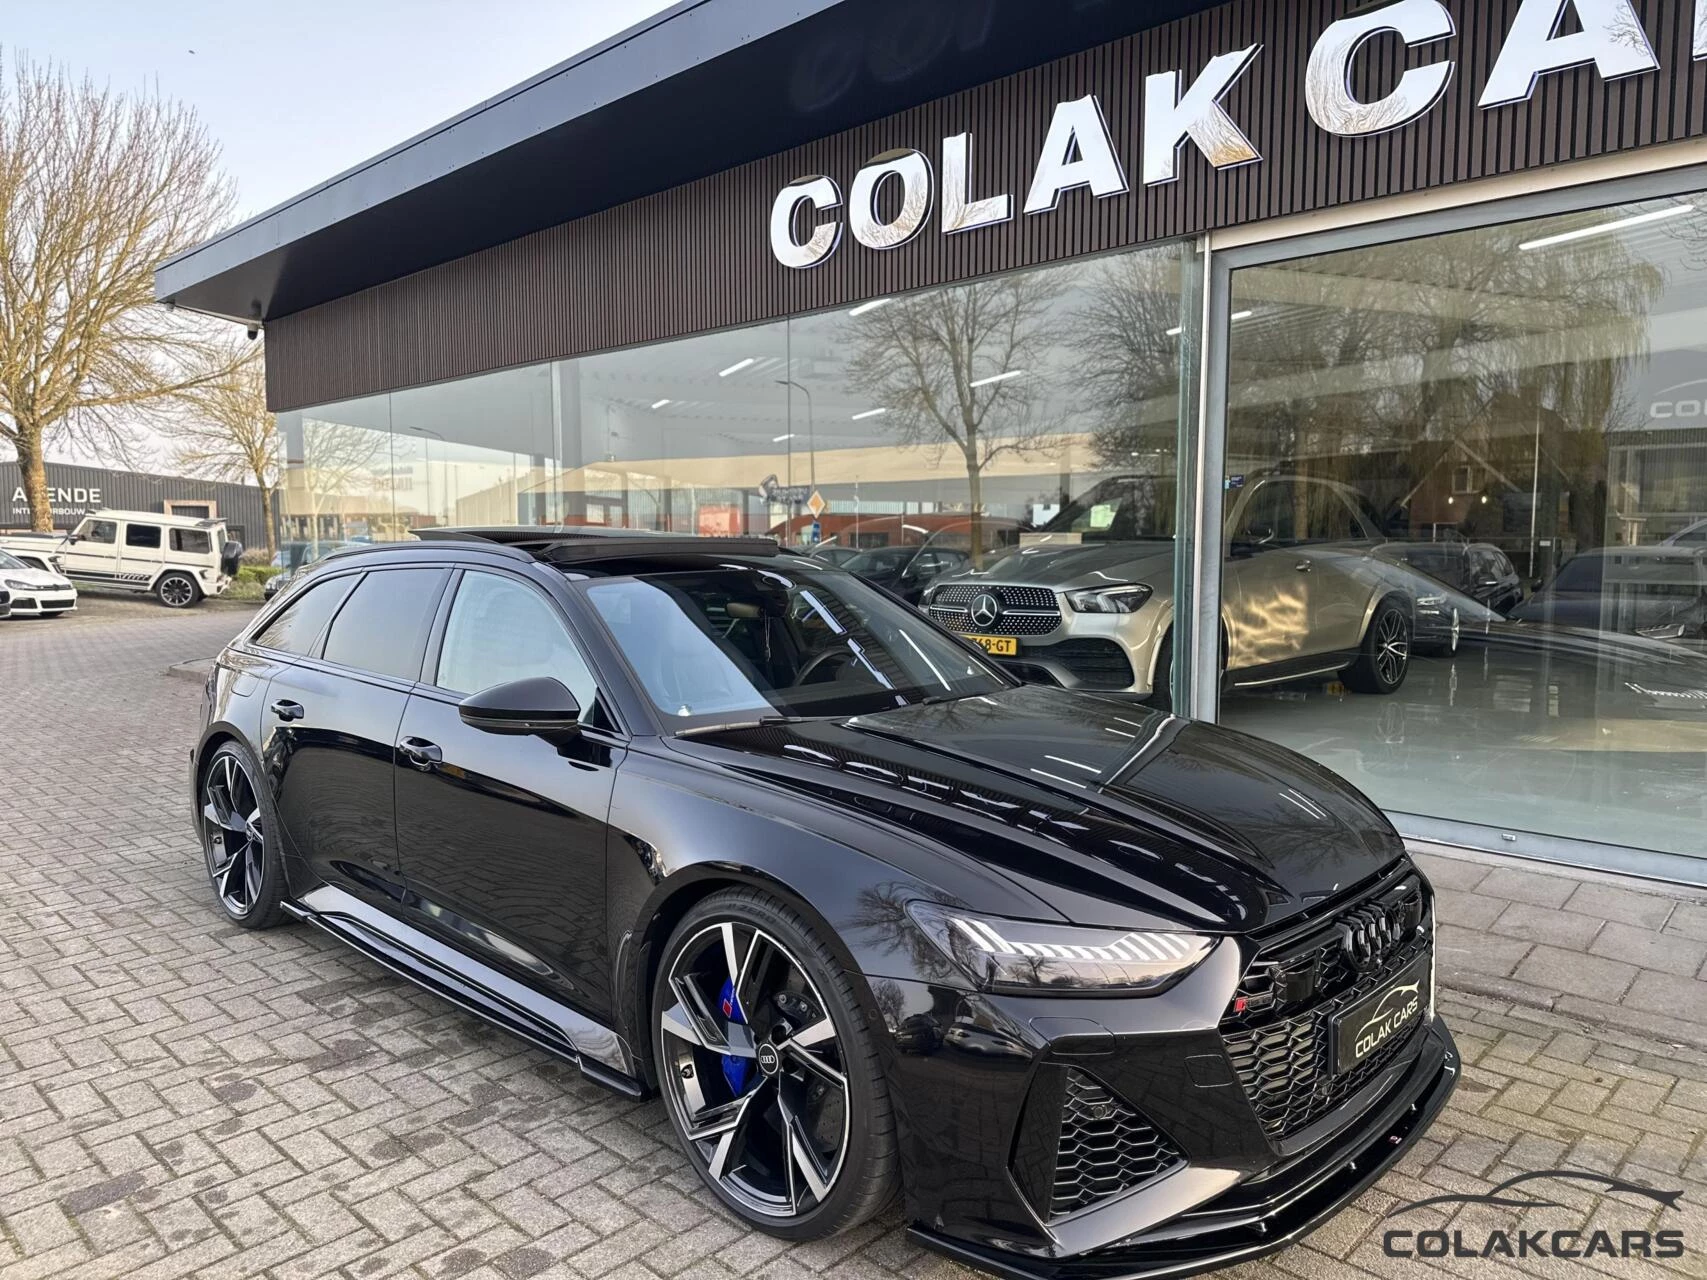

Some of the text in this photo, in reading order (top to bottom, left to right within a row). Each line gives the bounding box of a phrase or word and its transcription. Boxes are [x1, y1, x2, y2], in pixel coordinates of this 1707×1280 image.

[770, 43, 1264, 269] COLAK
[1305, 0, 1707, 138] CA
[1649, 398, 1707, 419] CO
[12, 487, 101, 503] AENDE
[1355, 995, 1418, 1058] COLAK CARS
